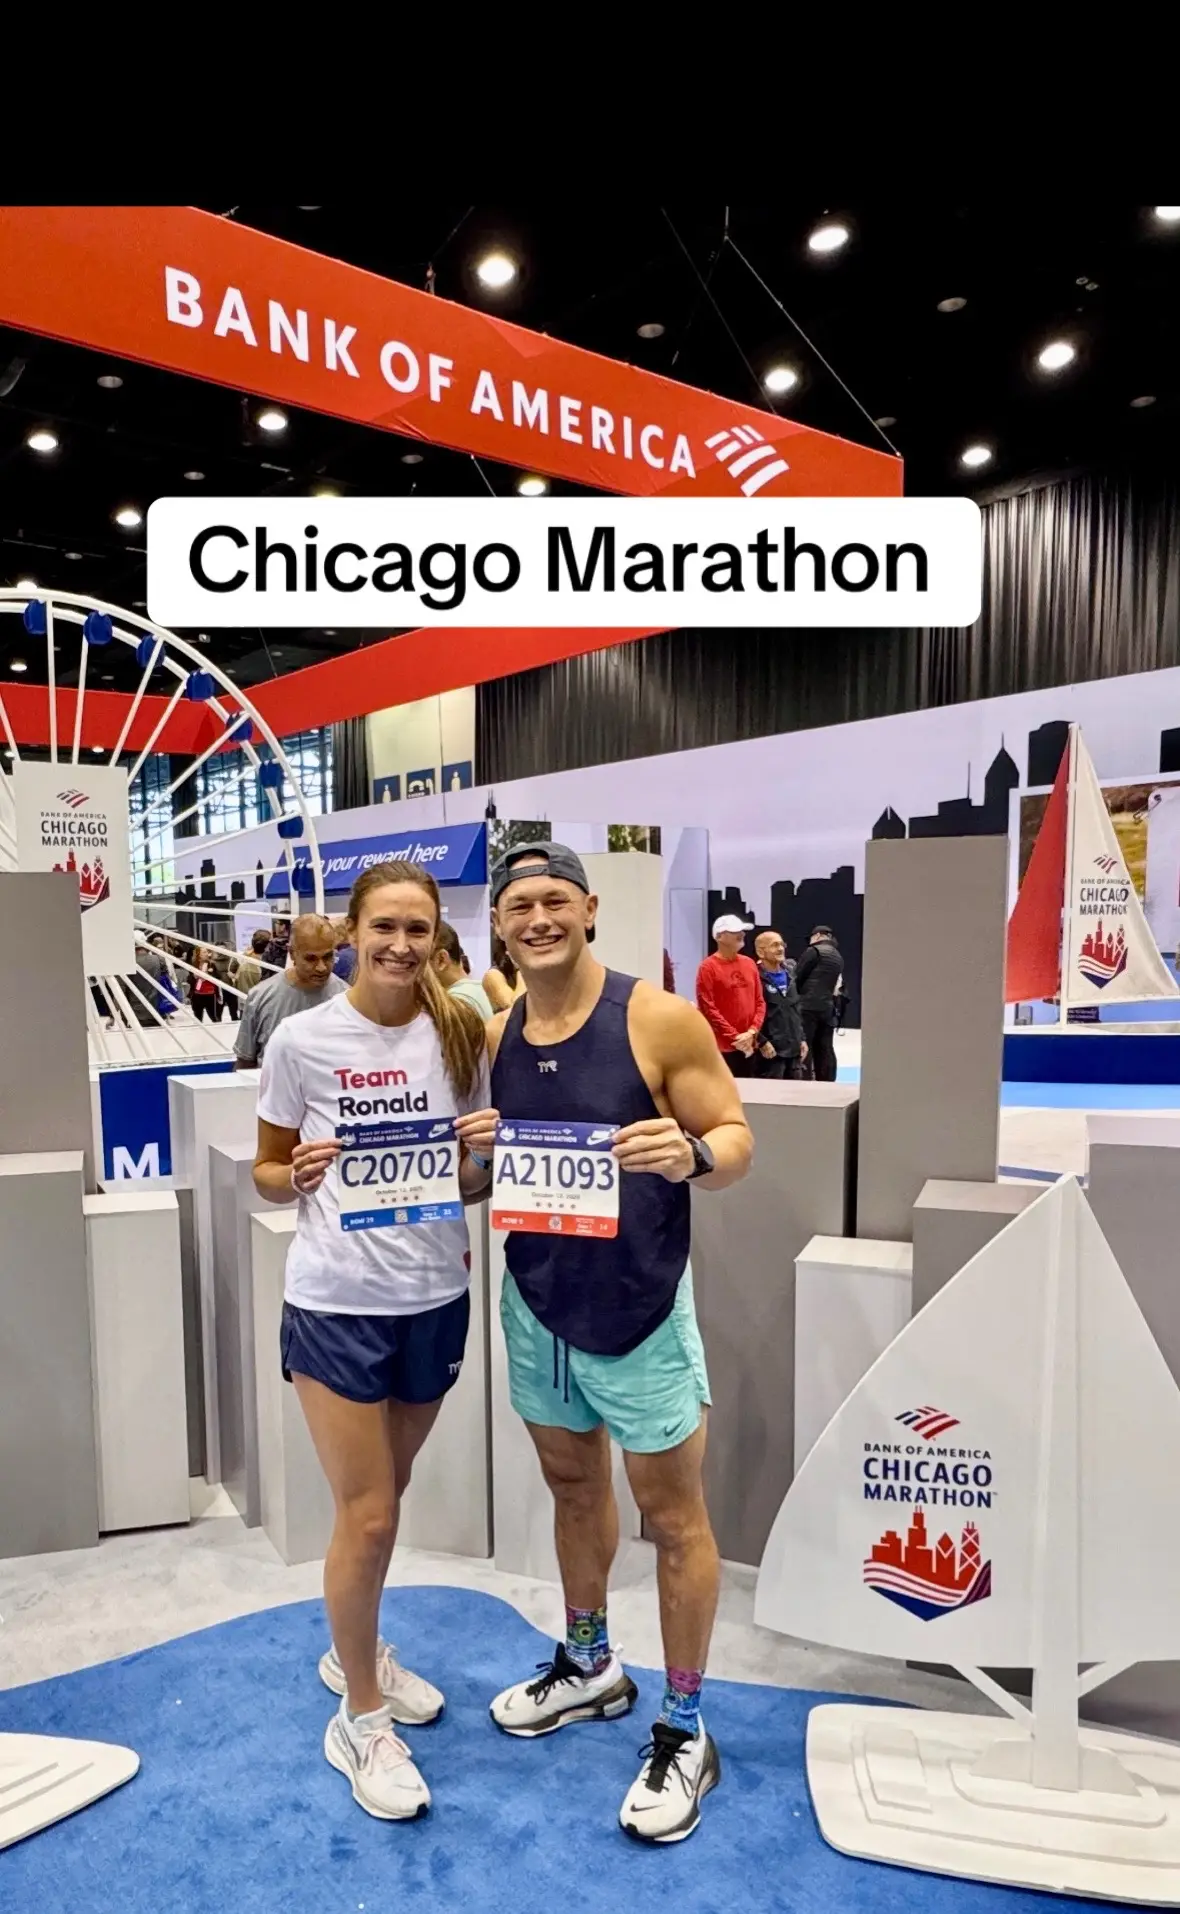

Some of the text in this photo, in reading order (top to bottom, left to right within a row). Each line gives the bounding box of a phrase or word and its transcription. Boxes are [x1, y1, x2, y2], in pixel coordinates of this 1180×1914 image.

[165, 265, 696, 478] BANK OF AMERICA
[41, 820, 108, 835] CHICAGO
[41, 836, 108, 847] MARATHON
[323, 855, 359, 877] your
[357, 844, 414, 869] reward
[410, 842, 449, 863] here
[1080, 887, 1129, 902] CHICAGO
[333, 1068, 408, 1090] Team
[338, 1090, 428, 1117] Ronald
[113, 1142, 160, 1180] M
[341, 1147, 453, 1187] C20702
[496, 1152, 614, 1191] A21093
[864, 1442, 992, 1460] BANK OF AMERICA
[863, 1457, 992, 1487] CHICAGO
[864, 1483, 992, 1508] MARATHON
